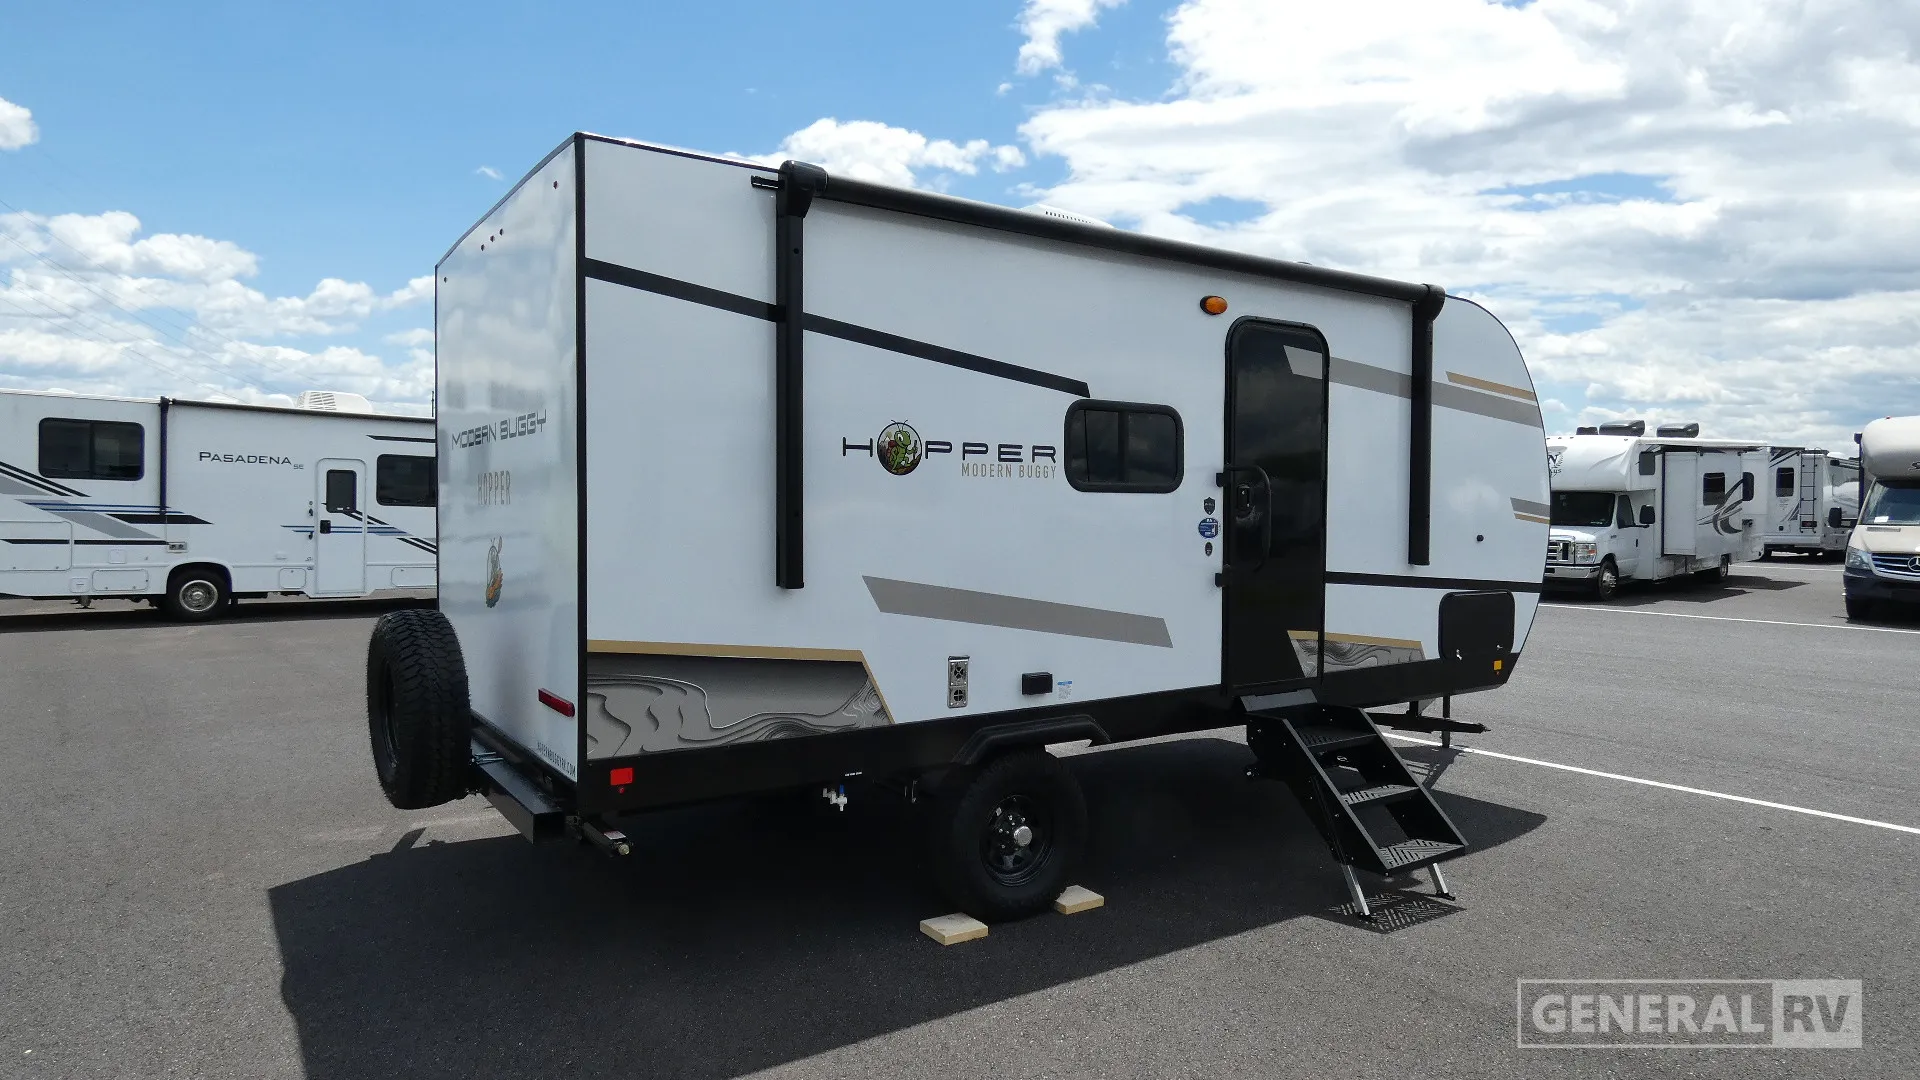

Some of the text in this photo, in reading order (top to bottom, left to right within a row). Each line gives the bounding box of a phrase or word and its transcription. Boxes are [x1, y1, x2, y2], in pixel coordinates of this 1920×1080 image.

[451, 408, 547, 451] MODERN BUGGY
[199, 452, 292, 465] PASADENA
[961, 462, 1057, 479] MODERN BUGGY
[477, 470, 511, 505] HOPPER
